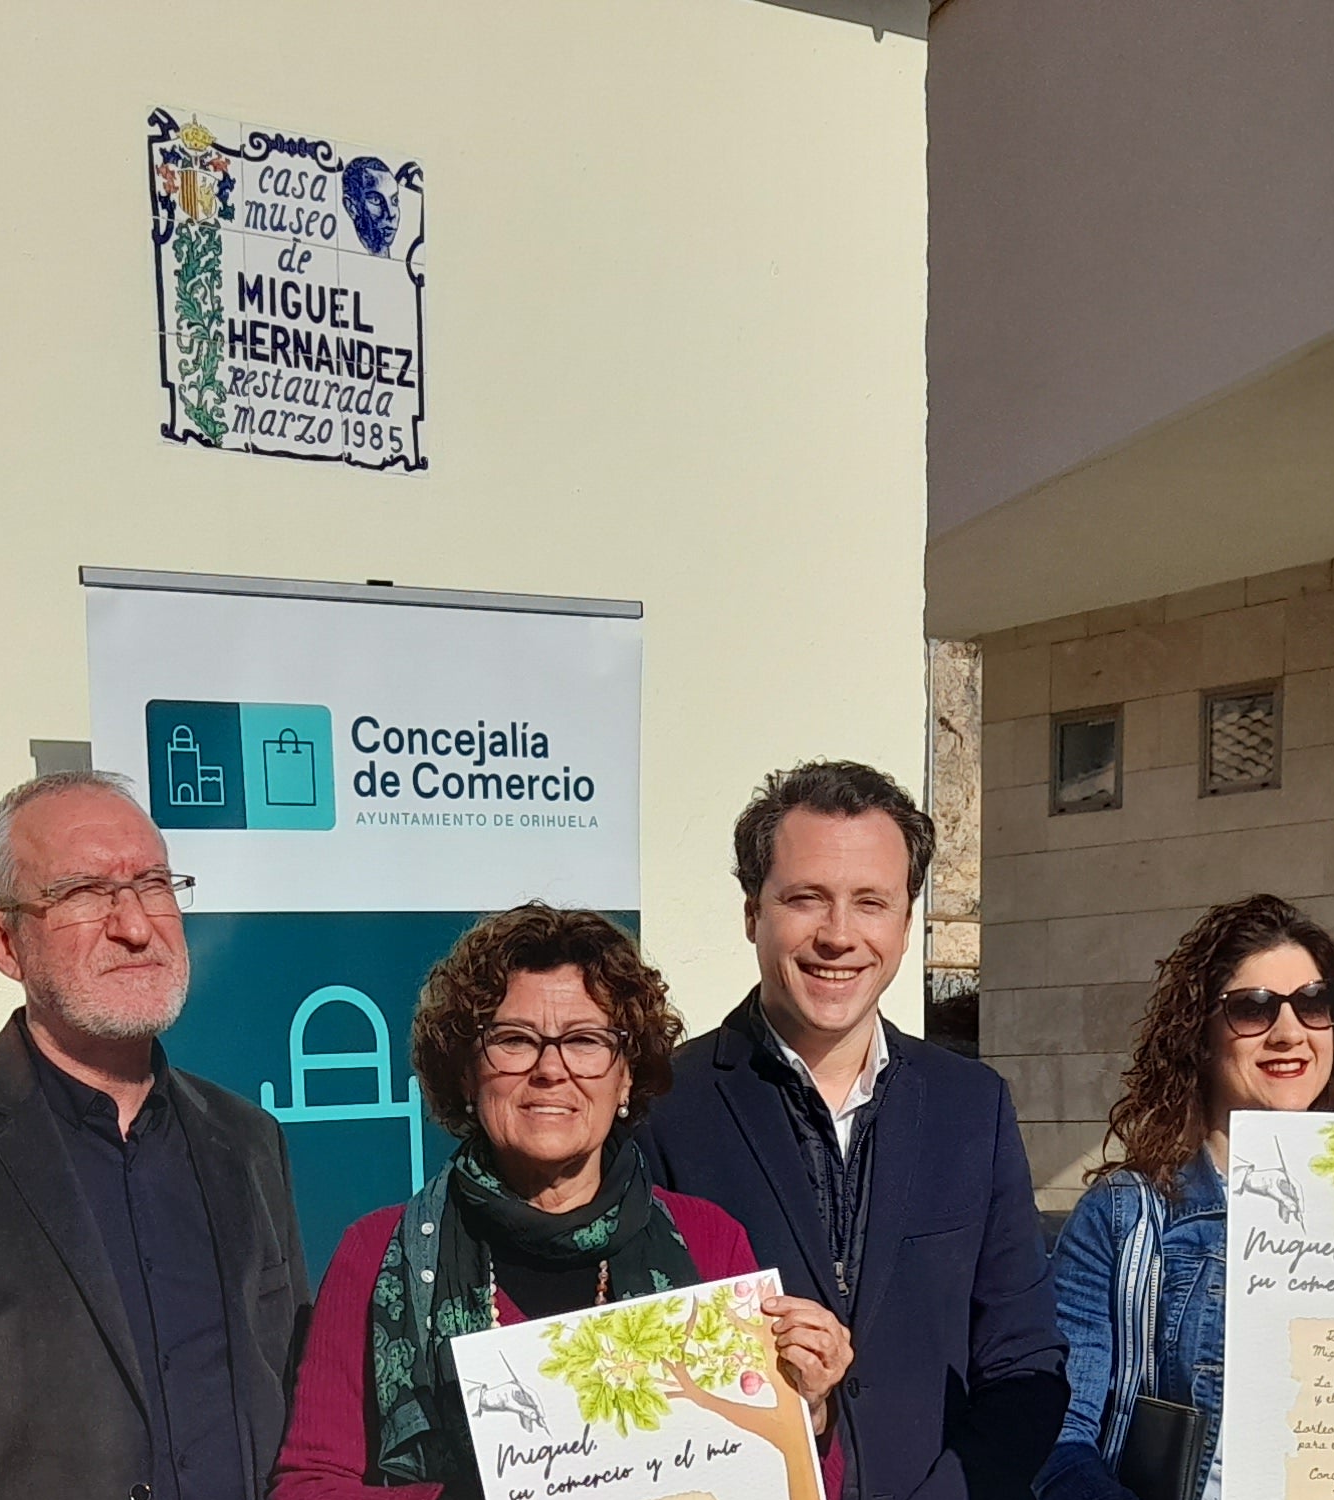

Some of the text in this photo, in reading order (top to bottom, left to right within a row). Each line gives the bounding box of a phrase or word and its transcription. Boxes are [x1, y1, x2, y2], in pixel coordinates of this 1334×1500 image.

[258, 165, 327, 202] casa
[244, 199, 337, 240] museo
[278, 239, 312, 274] de
[237, 271, 374, 334] MIGUEL
[228, 318, 416, 388] HERNANDEZ
[227, 364, 395, 418] Restaurada
[232, 403, 404, 454] marzo 1985
[351, 715, 550, 767] Concejalía
[353, 760, 595, 802] de Comercio
[356, 811, 599, 829] AYUNTAMIENTO DE ORIHUELA
[1246, 1274, 1277, 1295] su
[1313, 1375, 1332, 1388] La
[1314, 1395, 1322, 1407] y
[1296, 1440, 1326, 1452] para
[546, 1466, 634, 1496] comercio
[646, 1458, 663, 1483] y
[673, 1439, 695, 1469] el
